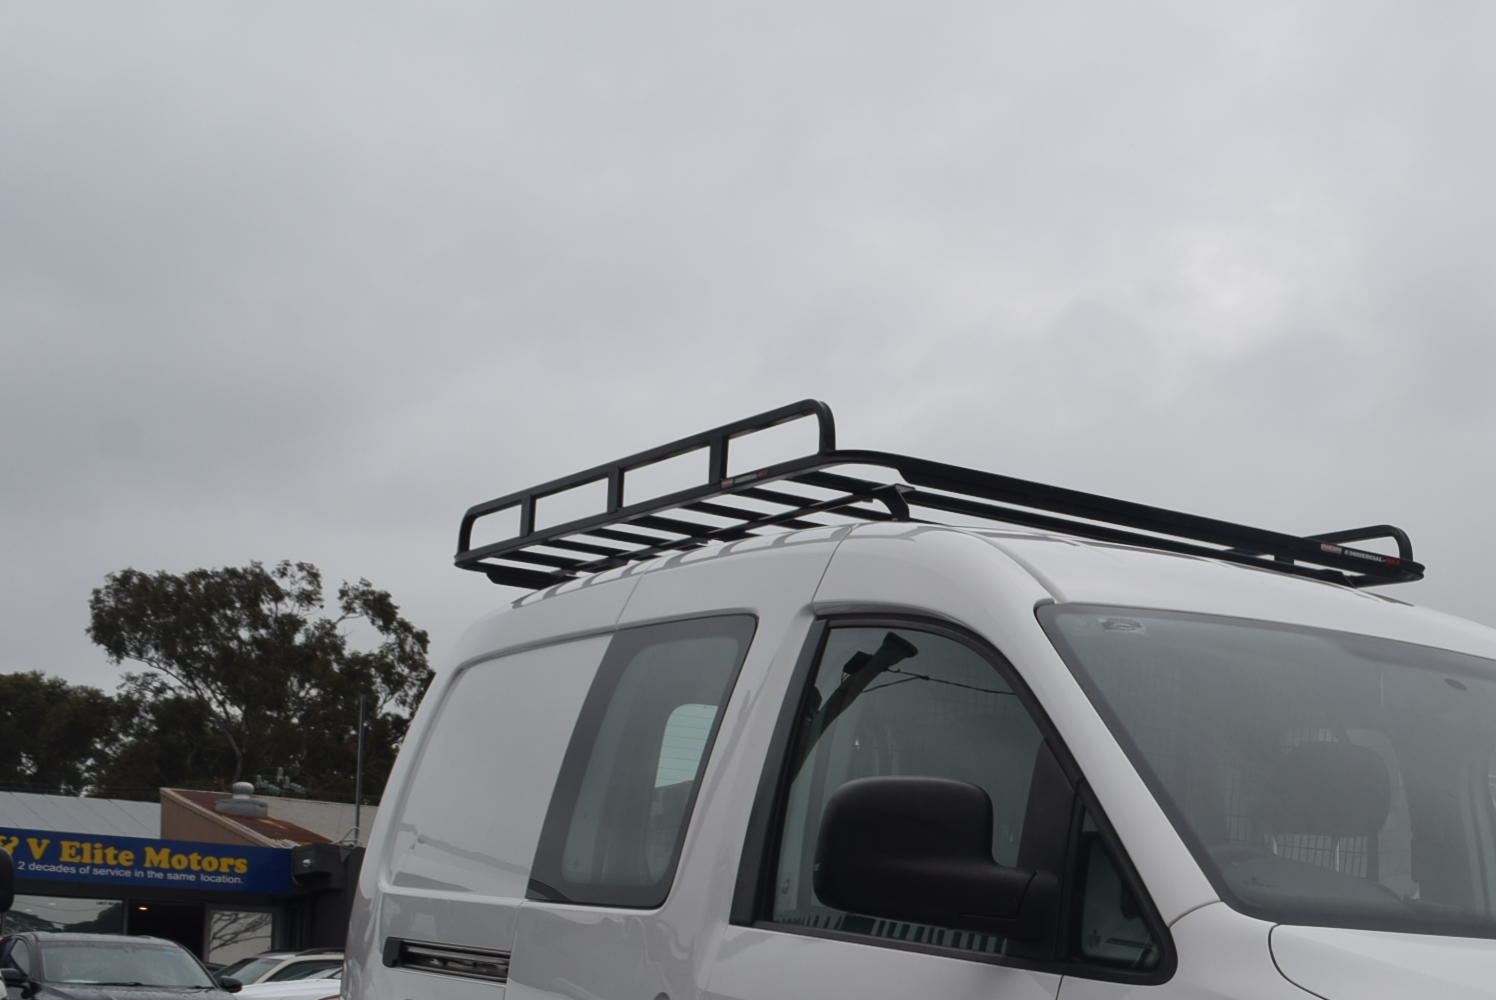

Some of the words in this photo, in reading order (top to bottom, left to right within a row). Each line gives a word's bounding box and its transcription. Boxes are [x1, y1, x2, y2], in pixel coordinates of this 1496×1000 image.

[27, 837, 51, 860] V
[60, 840, 135, 867] Elite
[144, 847, 249, 874] Motors
[18, 861, 25, 870] 2
[29, 862, 76, 874] decades
[79, 865, 90, 874] of
[93, 867, 131, 878] service
[134, 869, 144, 878] in
[147, 869, 164, 880] the
[167, 872, 196, 882] same
